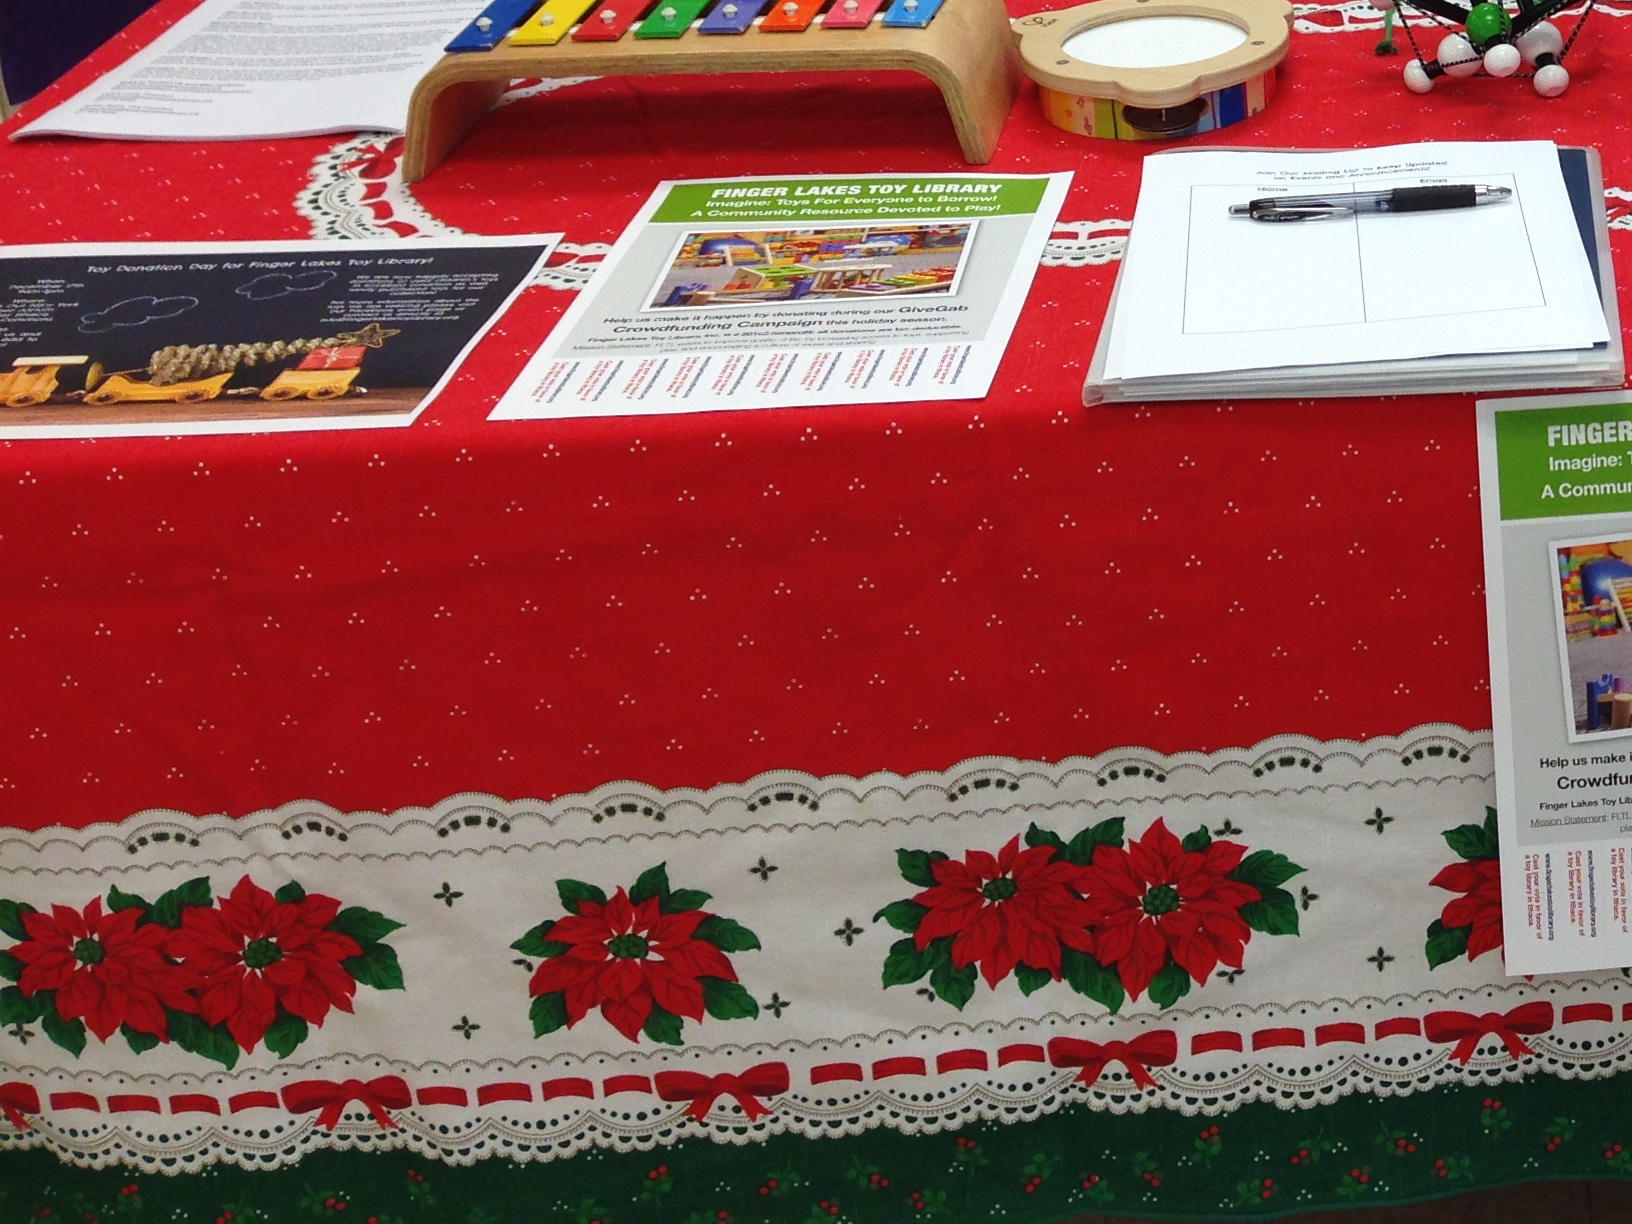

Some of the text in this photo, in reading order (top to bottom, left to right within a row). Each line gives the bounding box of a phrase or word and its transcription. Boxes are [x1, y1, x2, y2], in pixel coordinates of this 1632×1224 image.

[711, 184, 1003, 199] FINGER LAKES TOY LIBRARY
[706, 200, 771, 208] Imagine:
[777, 198, 810, 206] Toys
[843, 197, 914, 205] Everyone
[707, 209, 796, 217] Community
[877, 206, 941, 214] Devoted
[964, 204, 1002, 212] Play!
[87, 265, 112, 274] Toy
[116, 263, 183, 272] Donation
[189, 262, 218, 271] Day
[222, 261, 245, 269] for
[249, 260, 296, 269] Finger
[301, 259, 342, 267] Lakes
[348, 258, 372, 266] Toy
[703, 314, 751, 322] happen
[772, 310, 828, 318] donating
[898, 305, 969, 313] GiveGab
[612, 322, 733, 333] Crowdfunding
[736, 319, 823, 329] Campaign
[1548, 454, 1623, 472] Imagine:
[1541, 484, 1555, 499] A
[1539, 757, 1569, 769] Help
[1572, 757, 1588, 767] us
[1591, 752, 1626, 765] make
[1539, 801, 1569, 812] Finger
[1570, 798, 1599, 809] Lakes
[1601, 797, 1617, 808] Toy
